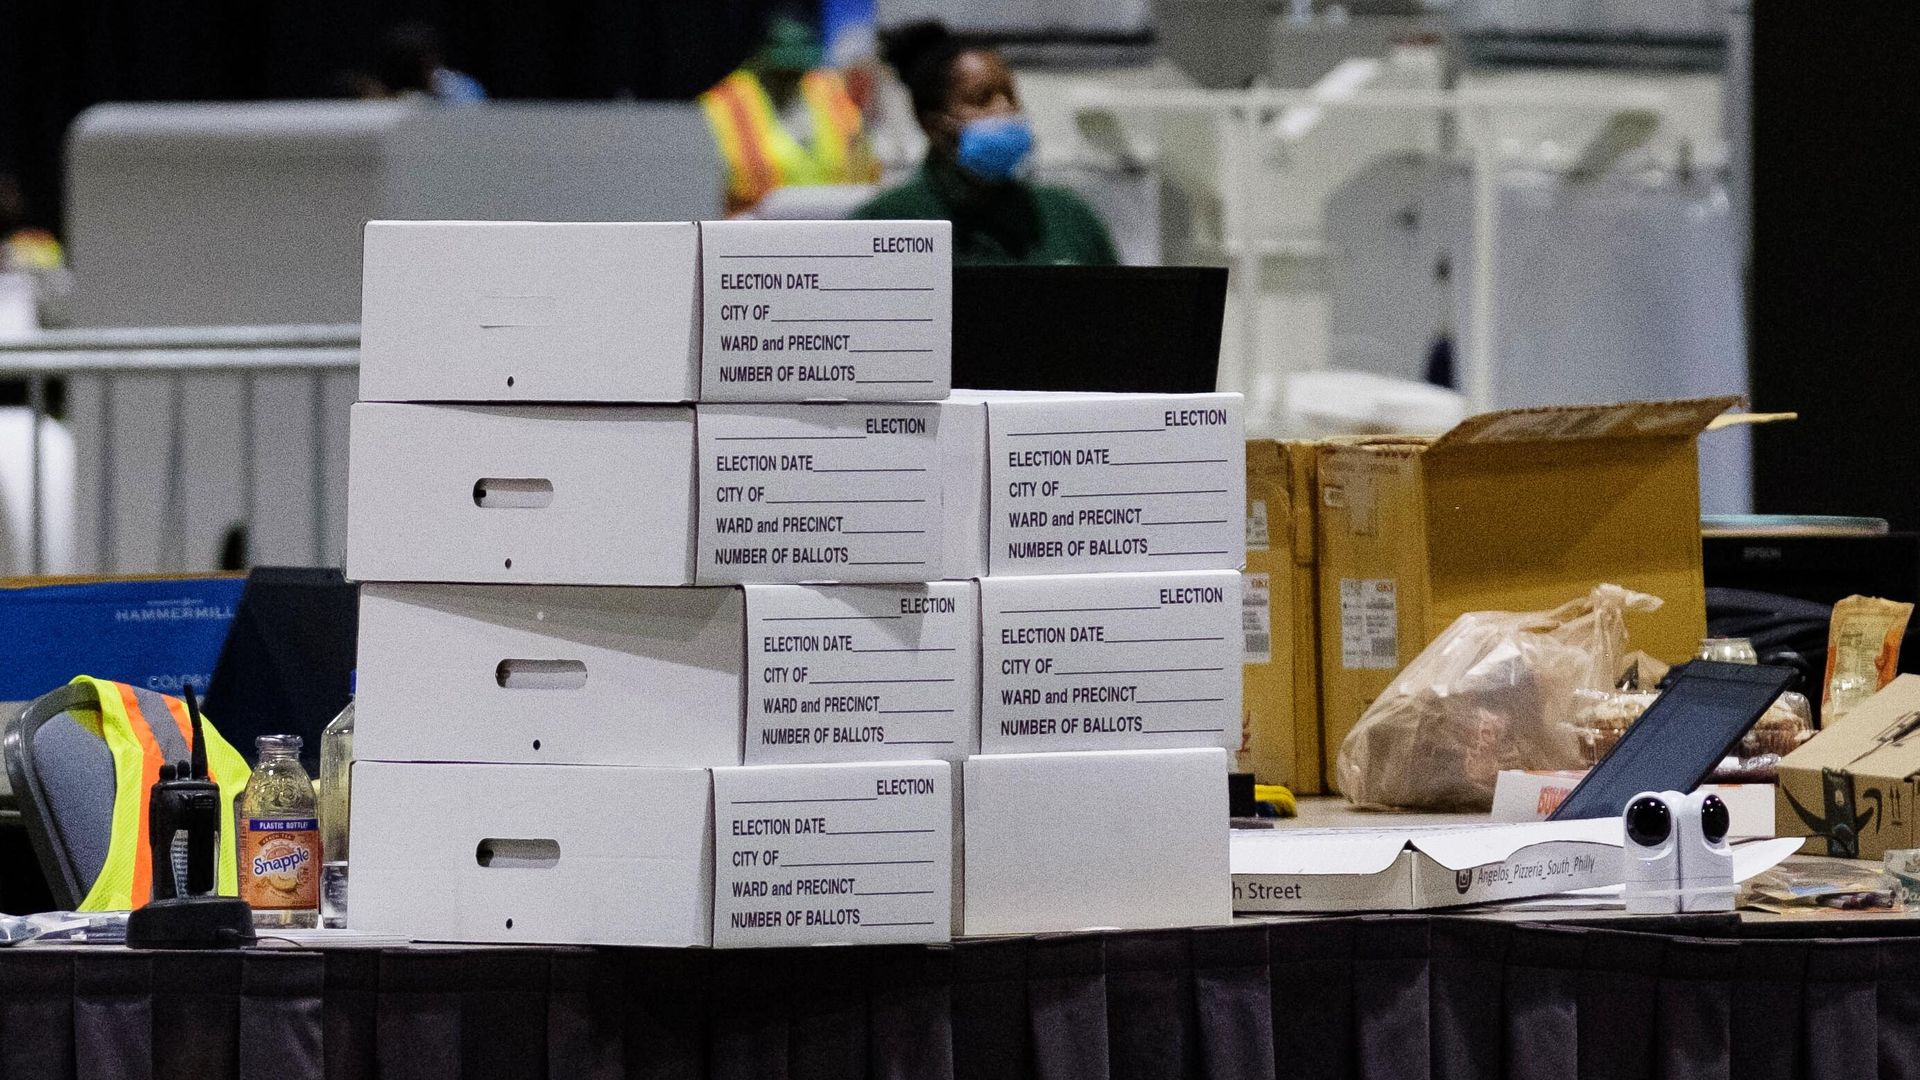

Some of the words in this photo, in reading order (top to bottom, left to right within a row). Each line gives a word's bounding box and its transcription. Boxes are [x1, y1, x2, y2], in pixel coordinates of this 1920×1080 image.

[873, 238, 933, 253] ELECTION
[721, 274, 782, 289] ELECTION
[787, 274, 819, 289] DATE
[721, 306, 748, 320] CITY
[753, 305, 770, 320] OF
[721, 336, 758, 351] WARD
[763, 336, 783, 350] and
[789, 335, 849, 350] PRECINCT
[720, 367, 772, 382] NUMBER
[778, 367, 794, 381] OF
[800, 366, 855, 381] BALLOTS
[867, 419, 925, 433] ELECTION
[1165, 410, 1226, 426] ELECTION
[717, 456, 776, 471] ELECTION
[781, 455, 813, 470] DATE
[1009, 451, 1071, 467] ELECTION
[1077, 450, 1109, 465] DATE
[717, 487, 743, 501] CITY
[748, 487, 764, 501] OF
[1009, 482, 1037, 497] CITY
[1042, 481, 1059, 496] OF
[716, 518, 752, 533] WARD
[758, 518, 778, 532] and
[783, 517, 843, 532] PRECINCT
[1009, 512, 1047, 527] WARD
[1052, 511, 1073, 526] and
[1079, 509, 1142, 525] PRECINCT
[715, 549, 767, 564] NUMBER
[772, 549, 788, 563] OF
[793, 548, 848, 563] BALLOTS
[1009, 542, 1063, 558] NUMBER
[1068, 541, 1085, 556] OF
[1090, 539, 1147, 555] BALLOTS
[1160, 588, 1222, 604] ELECTION
[115, 606, 234, 620] HAMMERMILL
[901, 598, 954, 613] ELECTION
[1002, 628, 1065, 644] ELECTION
[1071, 627, 1104, 642] DATE
[764, 637, 818, 652] ELECTION
[824, 636, 852, 651] DATE
[764, 668, 788, 683] CITY
[793, 667, 807, 682] OF
[1002, 660, 1030, 675] CITY
[1035, 659, 1052, 674] OF
[1002, 690, 1040, 705] WARD
[1045, 689, 1067, 704] and
[1073, 686, 1136, 703] PRECINCT
[764, 698, 797, 713] WARD
[801, 698, 820, 712] and
[825, 696, 879, 712] PRECINCT
[1001, 720, 1056, 736] NUMBER
[1061, 719, 1078, 734] OF
[1084, 716, 1142, 733] BALLOTS
[762, 729, 810, 744] NUMBER
[814, 728, 829, 743] OF
[833, 727, 884, 742] BALLOTS
[877, 779, 933, 795] ELECTION
[733, 820, 790, 835] ELECTION
[795, 818, 825, 834] DATE
[254, 847, 309, 875] Snapple
[733, 851, 758, 866] CITY
[763, 851, 779, 865] OF
[732, 881, 767, 897] WARD
[772, 881, 792, 896] and
[797, 879, 855, 895] PRECINCT
[1232, 881, 1242, 899] h
[1248, 882, 1302, 899] Street
[731, 912, 781, 928] NUMBER
[786, 911, 801, 926] OF
[806, 909, 860, 925] BALLOTS
